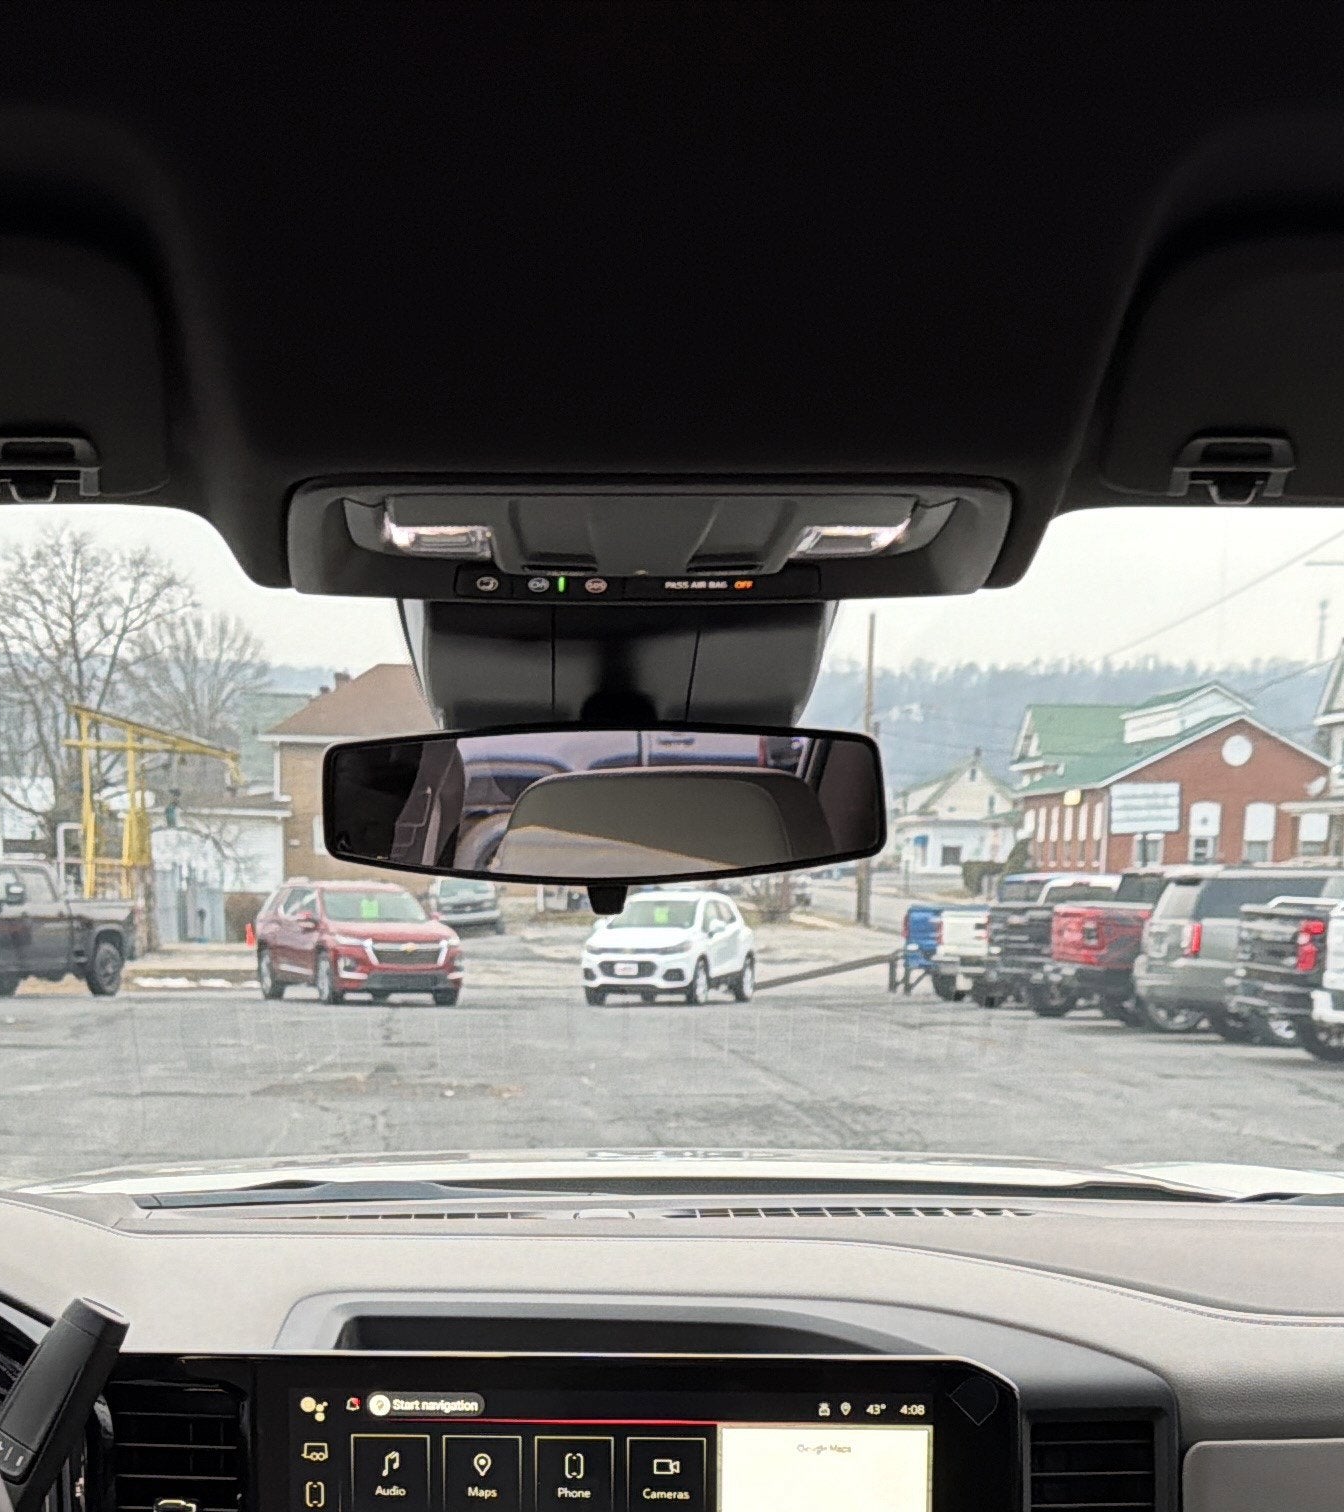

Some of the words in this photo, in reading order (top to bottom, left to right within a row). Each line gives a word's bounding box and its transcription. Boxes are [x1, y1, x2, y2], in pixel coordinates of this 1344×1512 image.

[734, 580, 754, 590] OFF
[392, 1398, 420, 1412] Start
[421, 1398, 479, 1414] navigation
[865, 1403, 887, 1415] 43°
[374, 1484, 407, 1498] Audio
[467, 1486, 498, 1500] Maps
[557, 1486, 592, 1500] Phone
[642, 1488, 691, 1501] Cameras
